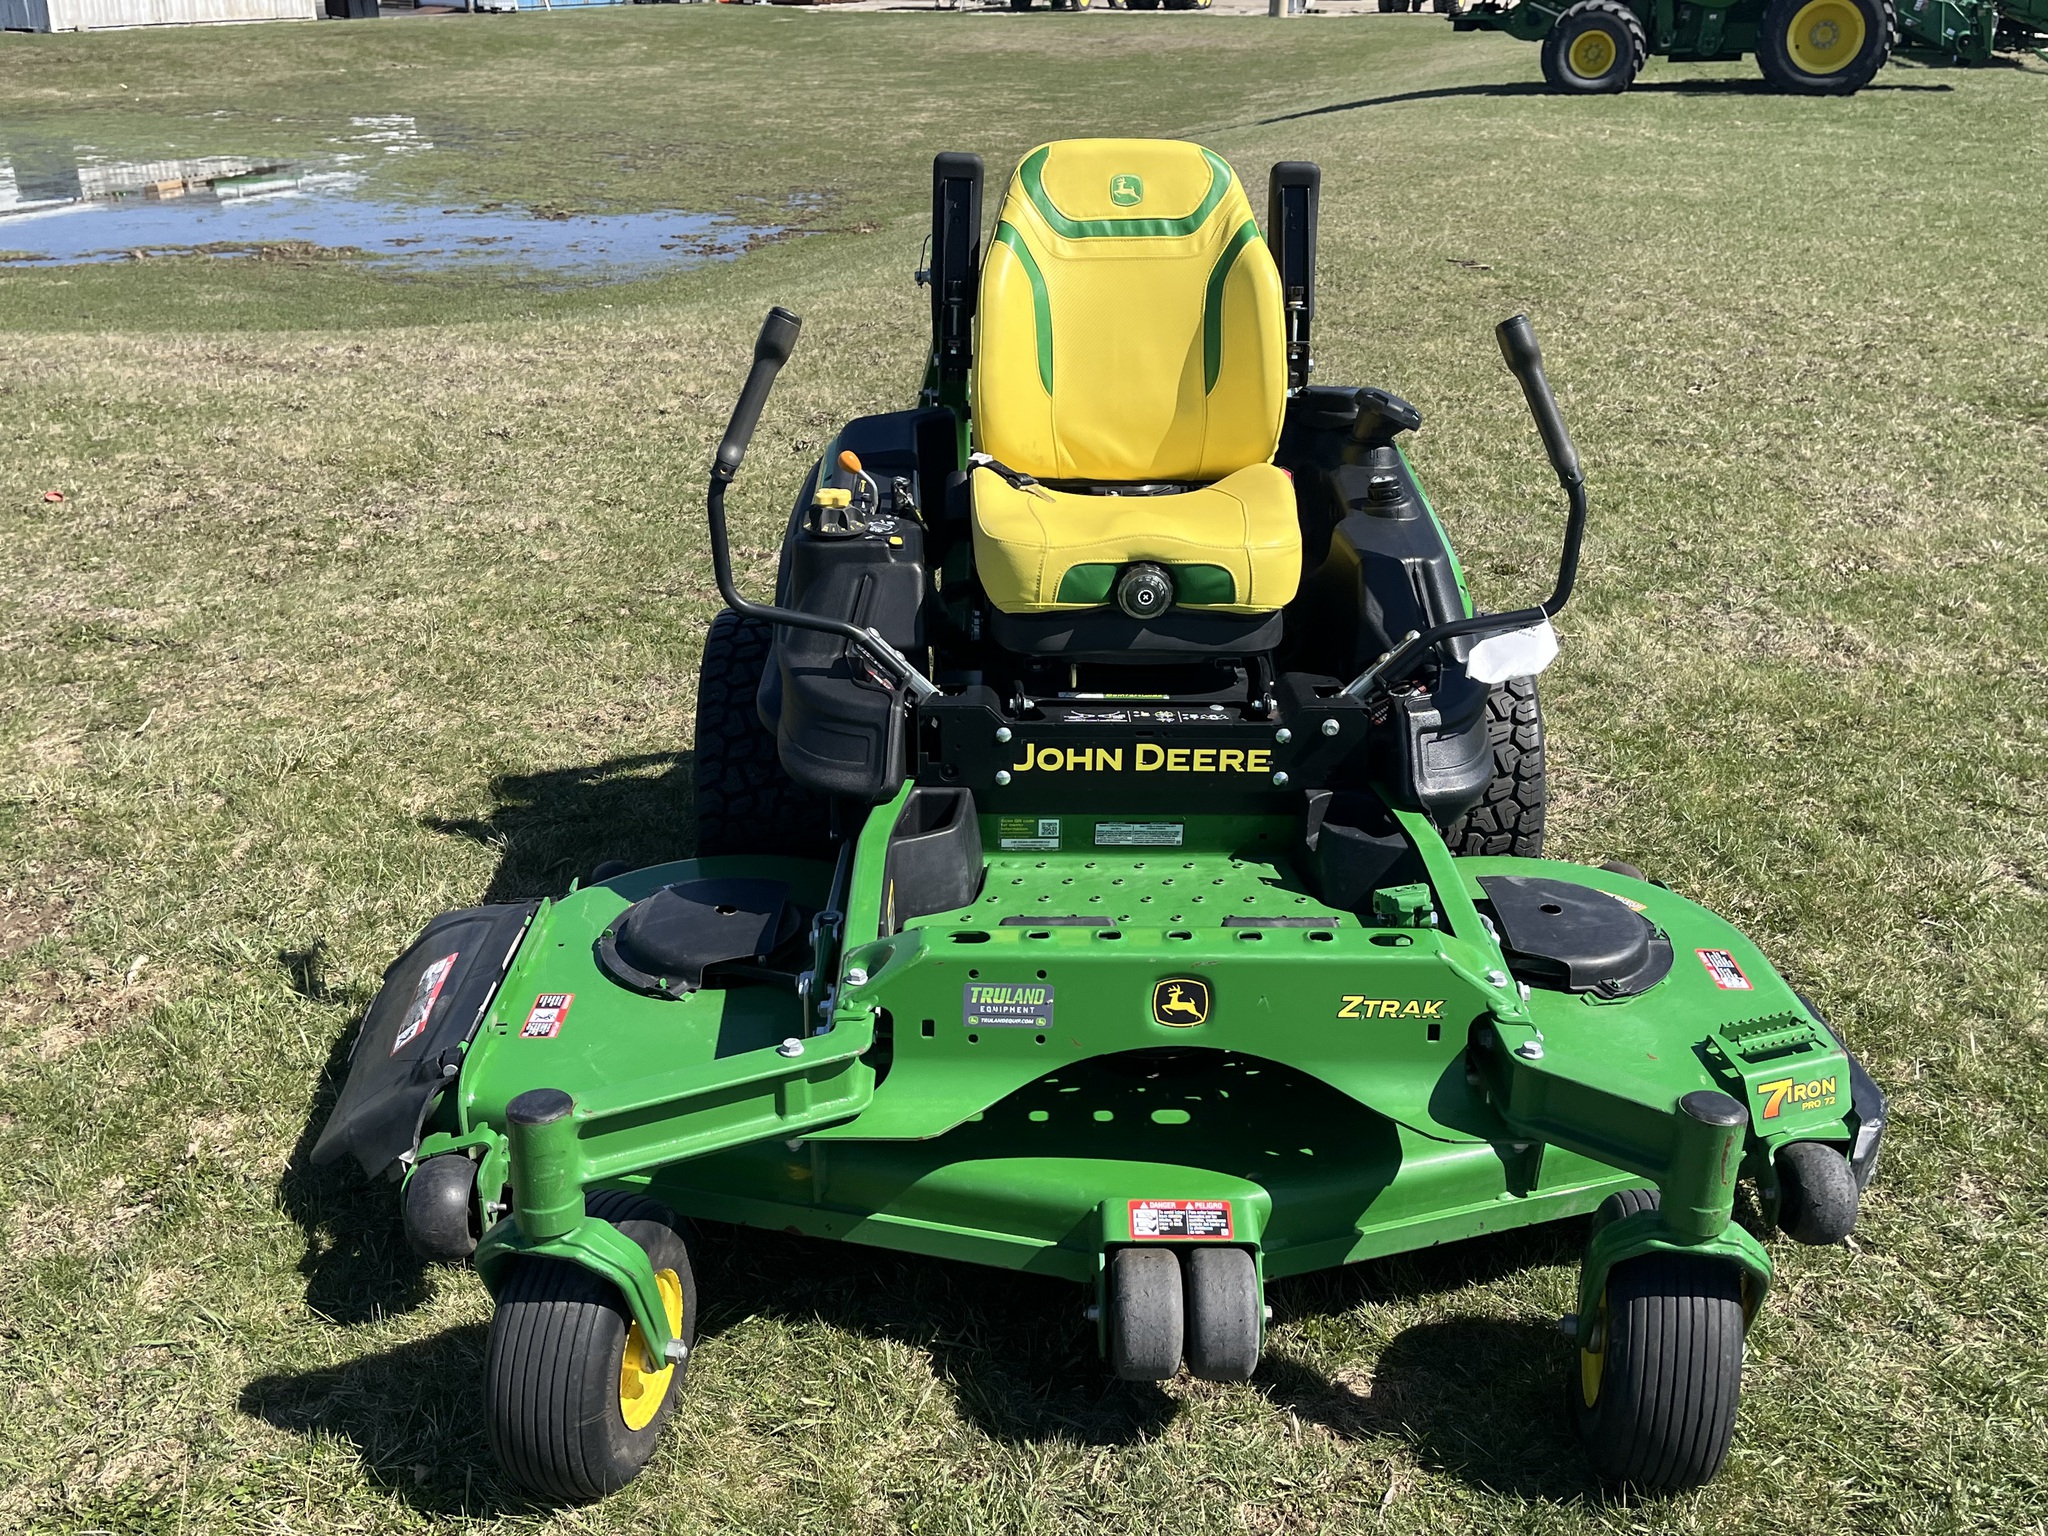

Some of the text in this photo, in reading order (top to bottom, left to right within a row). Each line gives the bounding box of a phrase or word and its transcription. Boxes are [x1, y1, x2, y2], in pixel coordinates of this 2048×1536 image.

[1013, 743, 1271, 772] JOHN DEERE
[970, 987, 1046, 1005] TRULAND
[980, 1005, 1035, 1014] EQUIPMENT
[1337, 994, 1445, 1019] ZTRAK
[1802, 1096, 1836, 1111] PRO 72
[1149, 1201, 1223, 1210] DANGER PELIGRO
